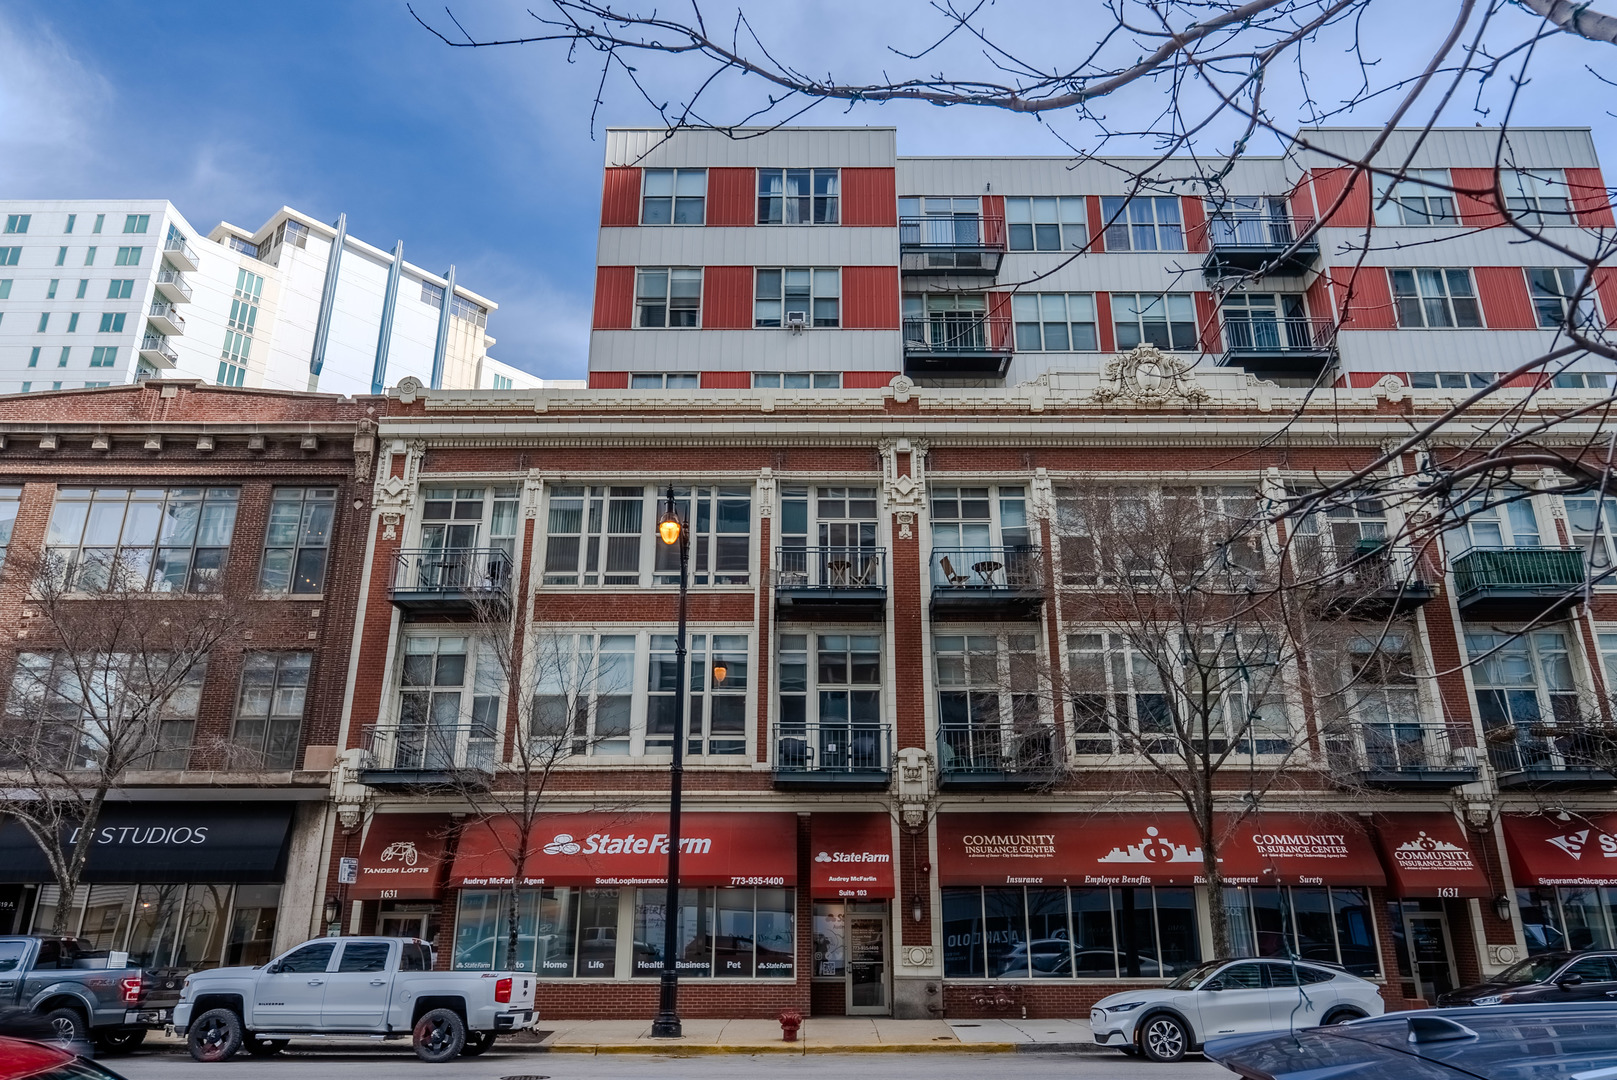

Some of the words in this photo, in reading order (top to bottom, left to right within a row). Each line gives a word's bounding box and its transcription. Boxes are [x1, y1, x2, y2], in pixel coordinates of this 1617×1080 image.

[98, 827, 209, 844] STUDIOS
[963, 835, 1055, 845] COMMUNITY
[1252, 834, 1345, 845] COMMUNITY
[1085, 876, 1120, 885] Employee
[1122, 875, 1151, 884] Benefits
[1218, 876, 1258, 885] nagement
[1300, 876, 1322, 885] Surety
[380, 890, 398, 898] 1631
[1438, 888, 1458, 897] 1631
